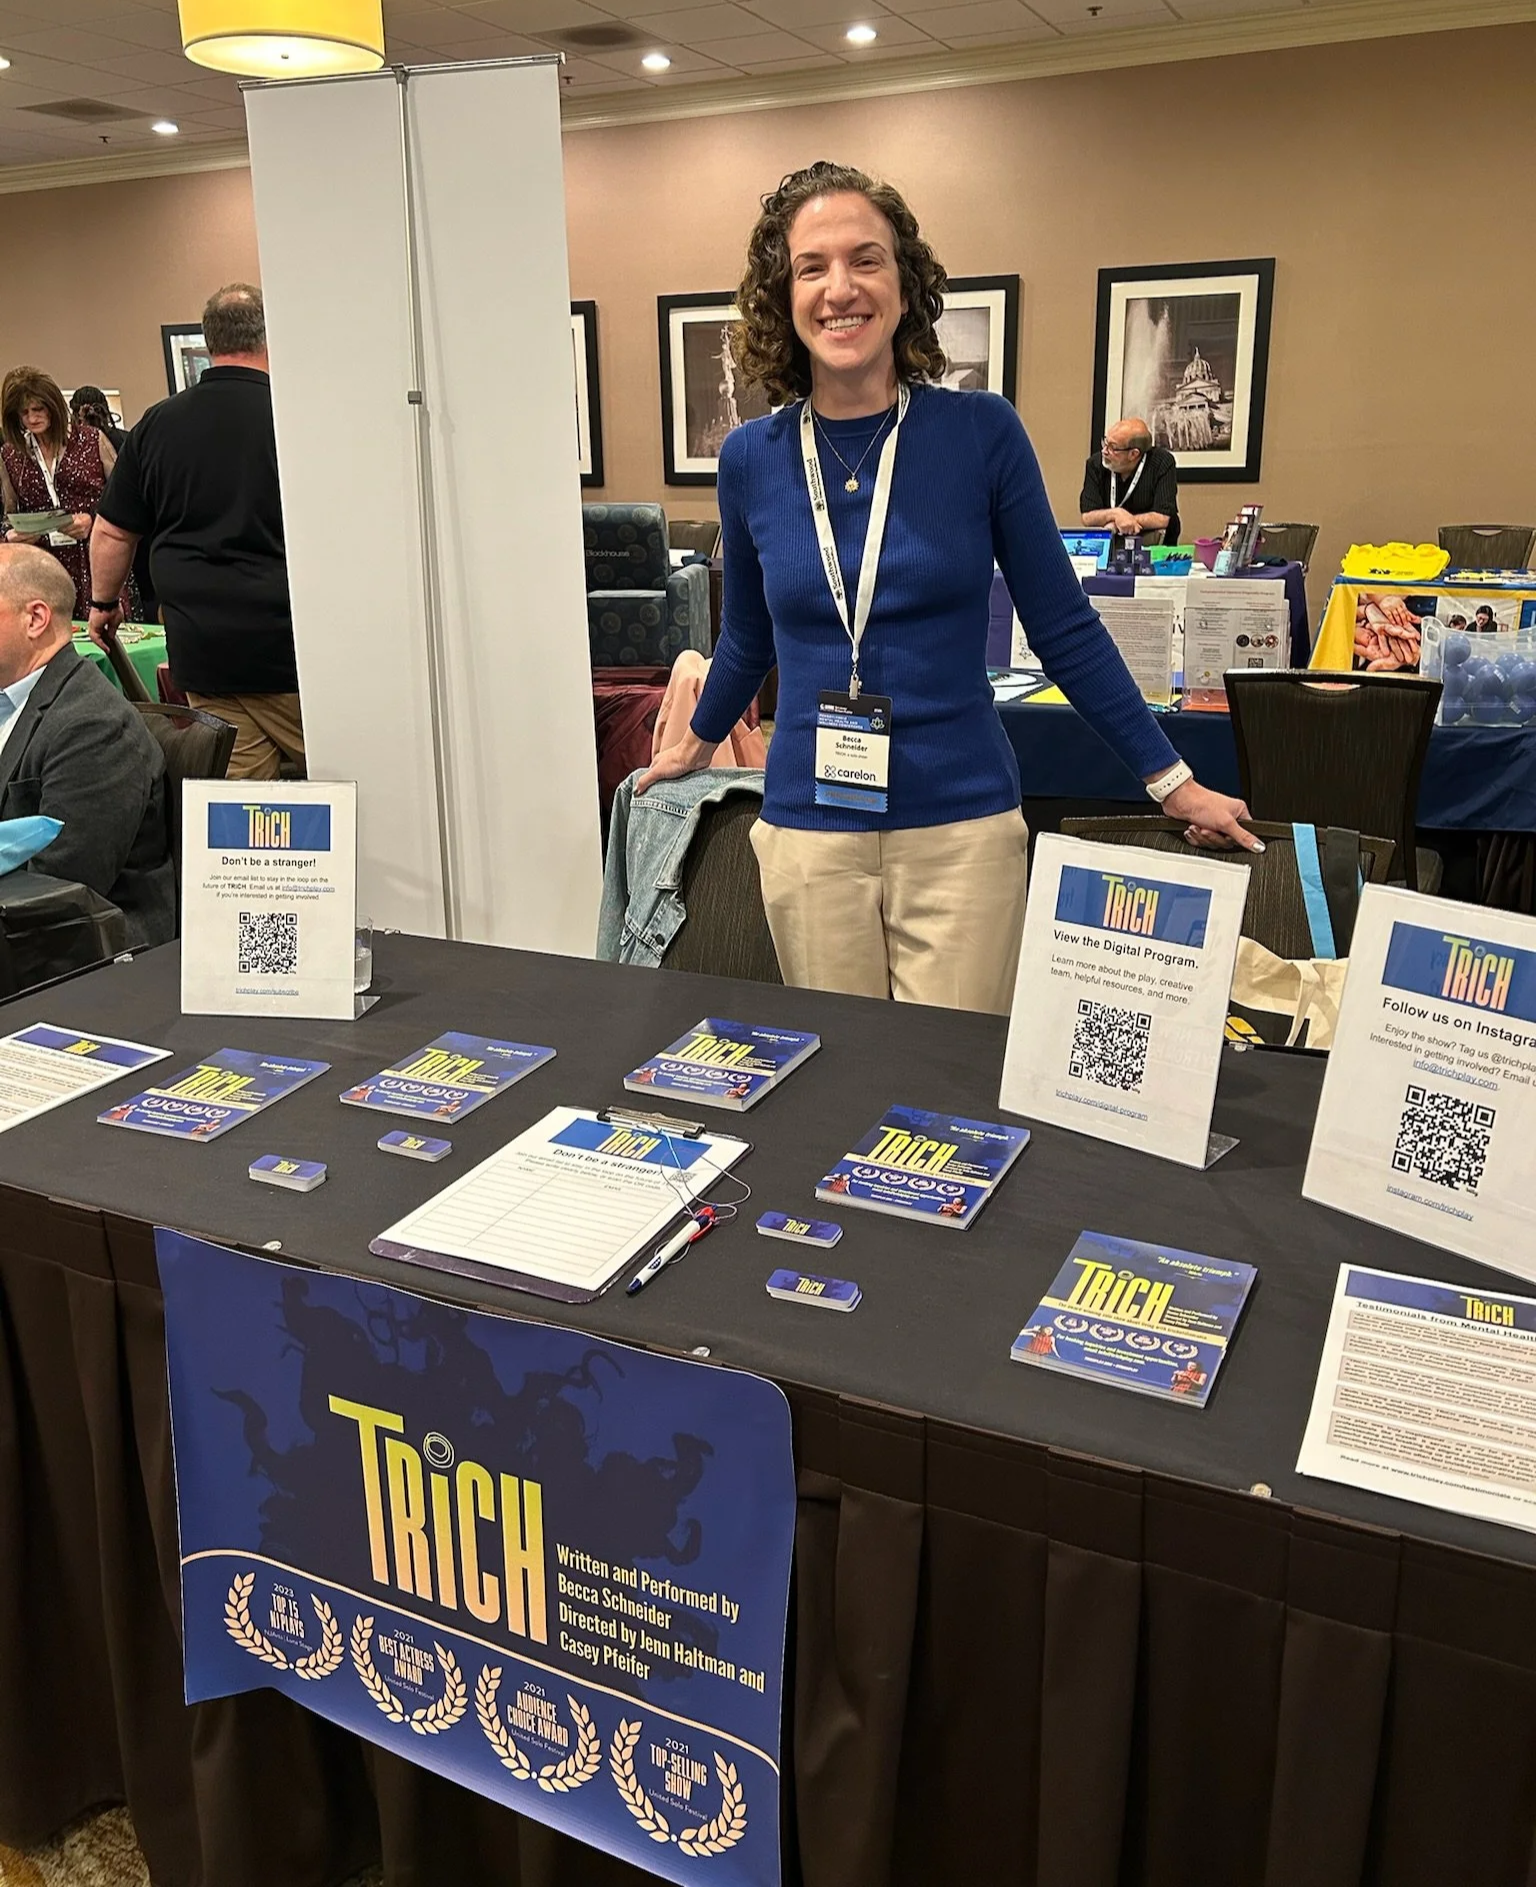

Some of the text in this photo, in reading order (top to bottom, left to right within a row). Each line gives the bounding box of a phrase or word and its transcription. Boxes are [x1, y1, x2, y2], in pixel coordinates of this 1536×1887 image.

[835, 742, 868, 752] Schneider
[842, 735, 862, 743] Becca
[837, 769, 876, 781] carelon
[222, 856, 247, 865] Don't
[250, 858, 261, 866] be
[272, 858, 316, 869] stranger!
[1054, 929, 1199, 969] View the Digital Program.
[1051, 954, 1194, 992] Learn more about the play, creative
[1051, 967, 1190, 1005] team, helpful resources, and more.
[1382, 997, 1536, 1048] Follow us on Instagra
[1370, 1032, 1530, 1085] Interested in getting involved? Email
[1385, 1024, 1536, 1073] Enjoy the show? Tag us @trichpla
[1413, 1059, 1498, 1091] info@trichplay.com
[553, 1149, 583, 1159] Don't
[1357, 1301, 1426, 1320] Testimonials
[1431, 1316, 1457, 1326] from
[1461, 1322, 1500, 1335] Mental
[273, 1583, 294, 1597] 2023
[556, 1543, 740, 1624] Written and Performed by
[271, 1593, 299, 1619] TOP 15
[558, 1572, 672, 1630] Becca Schneider
[270, 1610, 305, 1638] NJ PLAYS
[393, 1629, 414, 1643] 2021
[378, 1634, 434, 1672] BEST ACTRESS
[559, 1601, 766, 1693] Directed by Jenn Haltman and
[559, 1631, 650, 1680] Casey Pfeifer
[384, 1675, 434, 1700] United Solo Festival
[394, 1658, 423, 1686] AWARD
[523, 1681, 545, 1697] 2021
[517, 1690, 557, 1723] AUDIENCE
[507, 1704, 569, 1748] CHOICE AWARD
[512, 1729, 565, 1757] United Solo Festival
[665, 1737, 689, 1754] 2021
[650, 1743, 707, 1787] TOP-SELLING
[664, 1771, 692, 1801] SHOW
[649, 1788, 708, 1820] United Solo Festival
